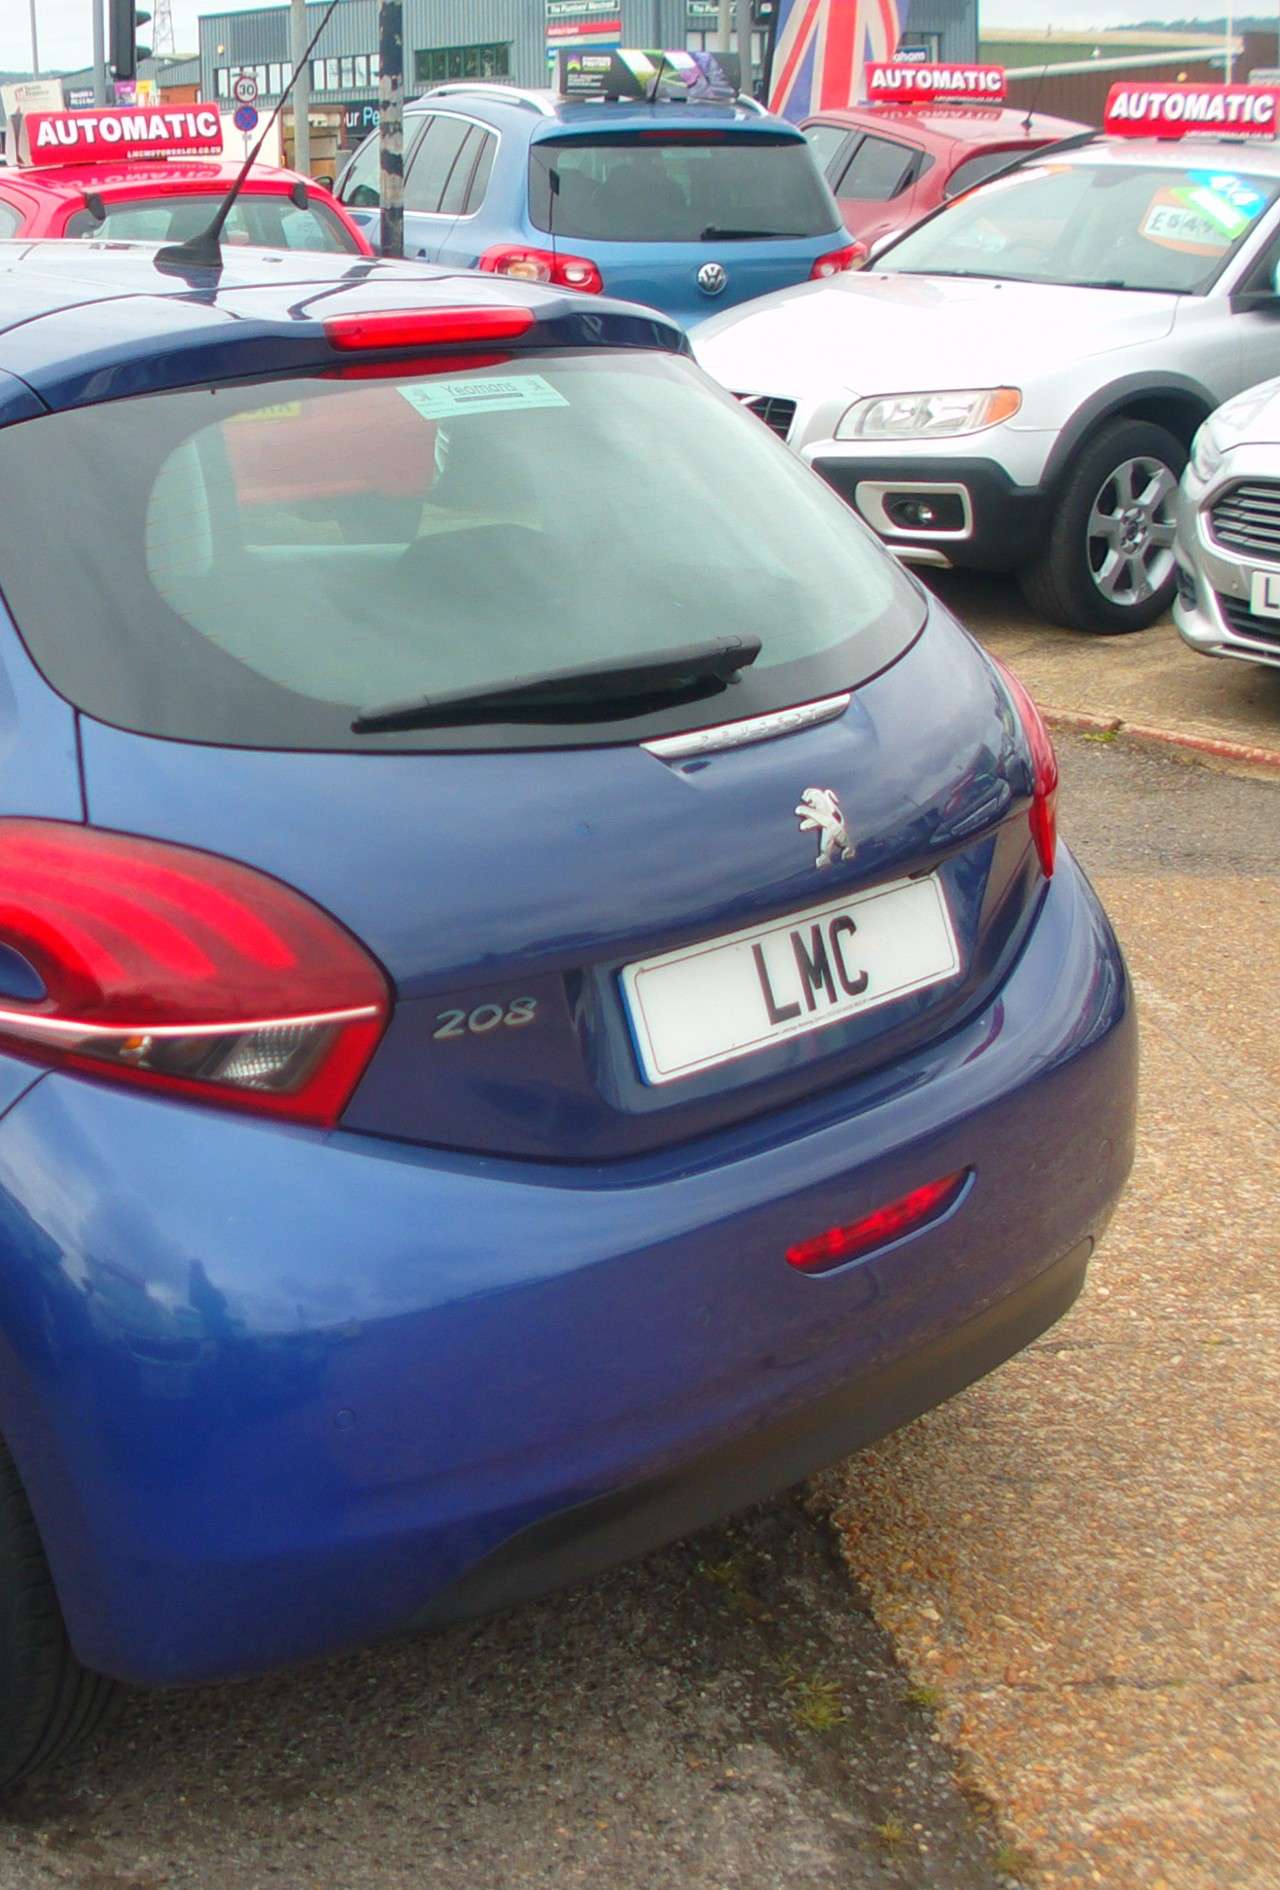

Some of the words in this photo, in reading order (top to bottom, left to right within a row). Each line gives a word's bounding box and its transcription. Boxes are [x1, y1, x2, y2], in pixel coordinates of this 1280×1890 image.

[239, 84, 255, 96] 30
[871, 69, 1002, 91] AUTOMATIC
[344, 111, 360, 128] ur
[363, 106, 380, 128] Pe
[1109, 92, 1274, 123] AUTOMATIC
[36, 112, 219, 147] AUTOMATIC
[440, 382, 518, 397] Yeomans
[750, 914, 869, 1026] LMC
[433, 997, 538, 1040] 208
